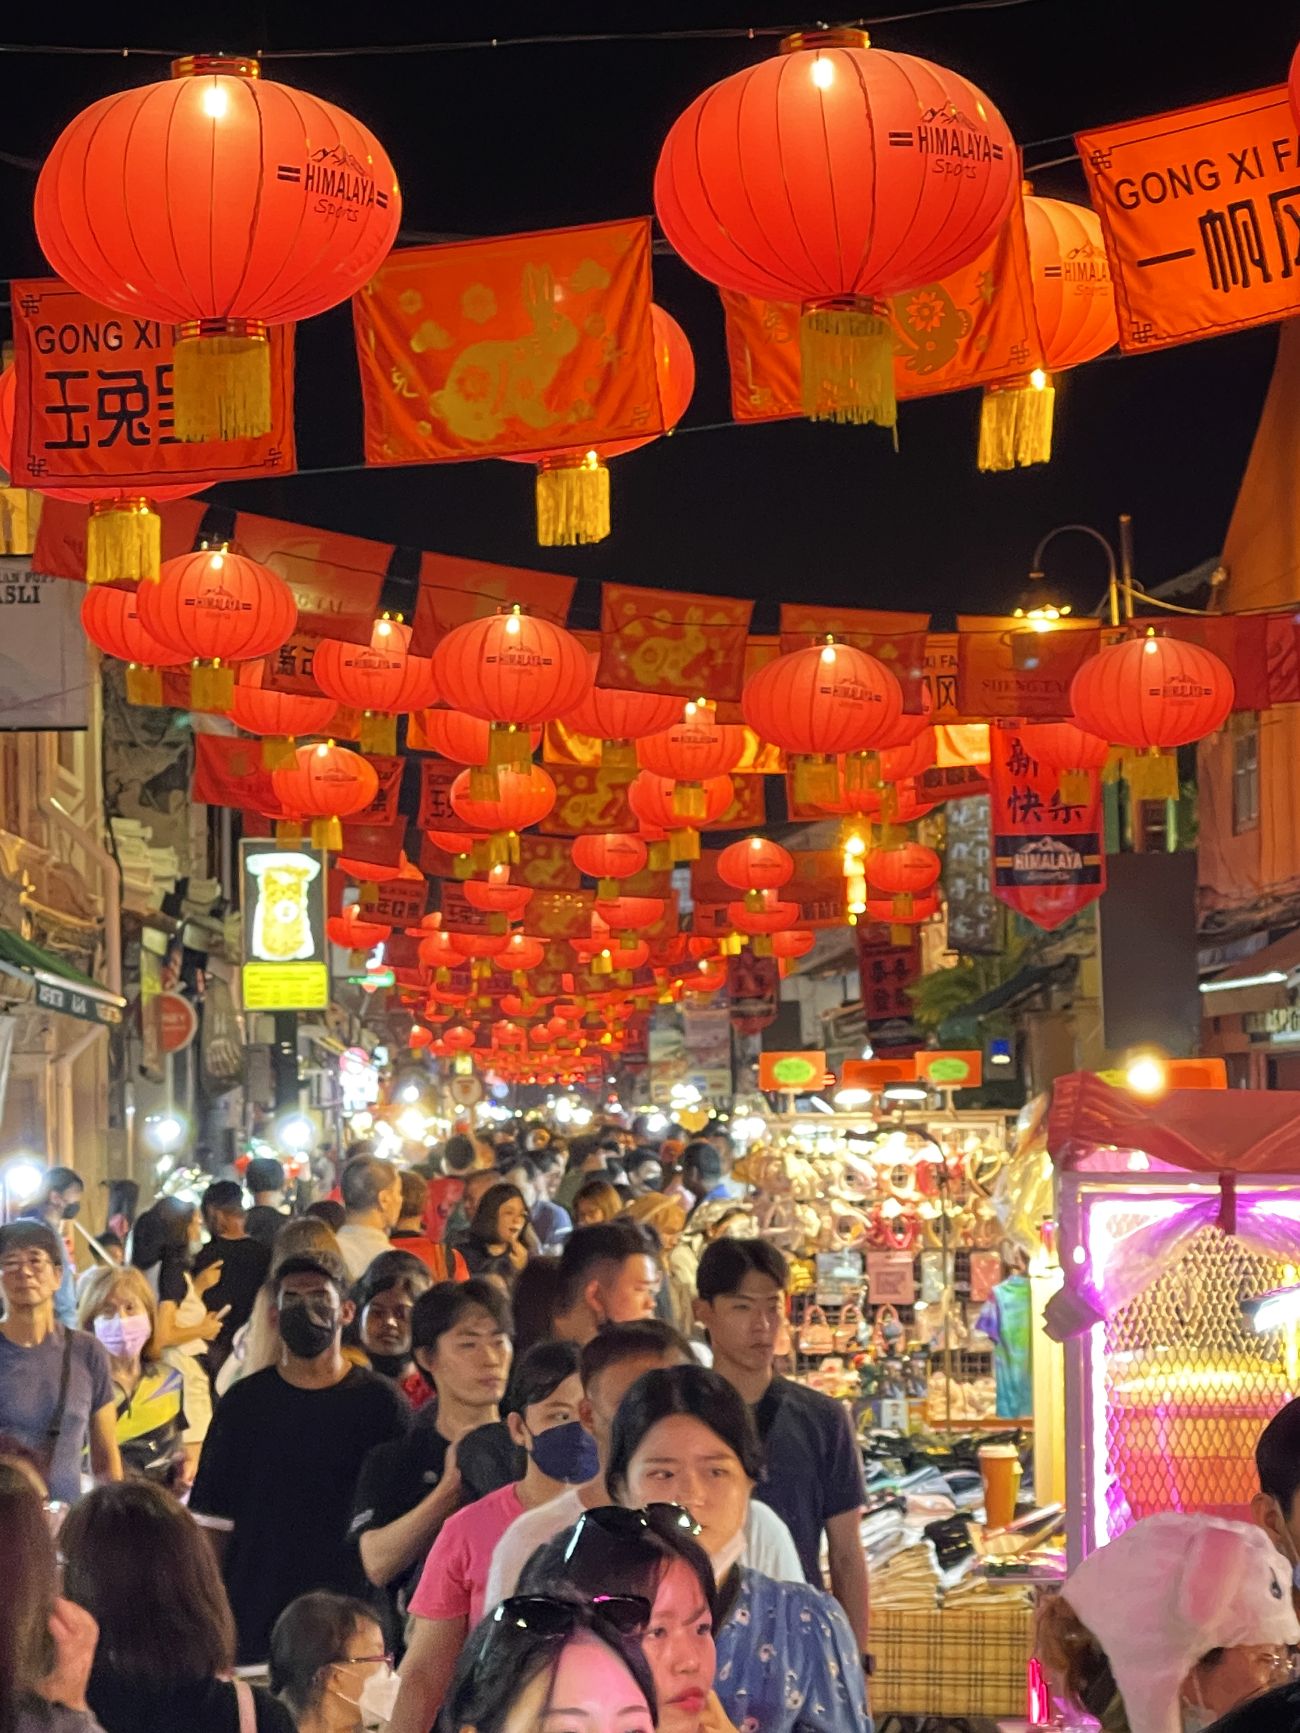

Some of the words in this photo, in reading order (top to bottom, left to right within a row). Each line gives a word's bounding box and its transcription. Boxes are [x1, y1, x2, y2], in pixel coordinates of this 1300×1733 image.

[917, 125, 991, 163] HIMALAYA
[304, 163, 375, 208] HIMALAYA
[1115, 158, 1221, 210] GONG
[1227, 145, 1264, 184] XI
[1272, 137, 1300, 172] F
[34, 320, 123, 354] GONG
[133, 319, 161, 350] XI
[1013, 852, 1083, 870] HIMALAYA
